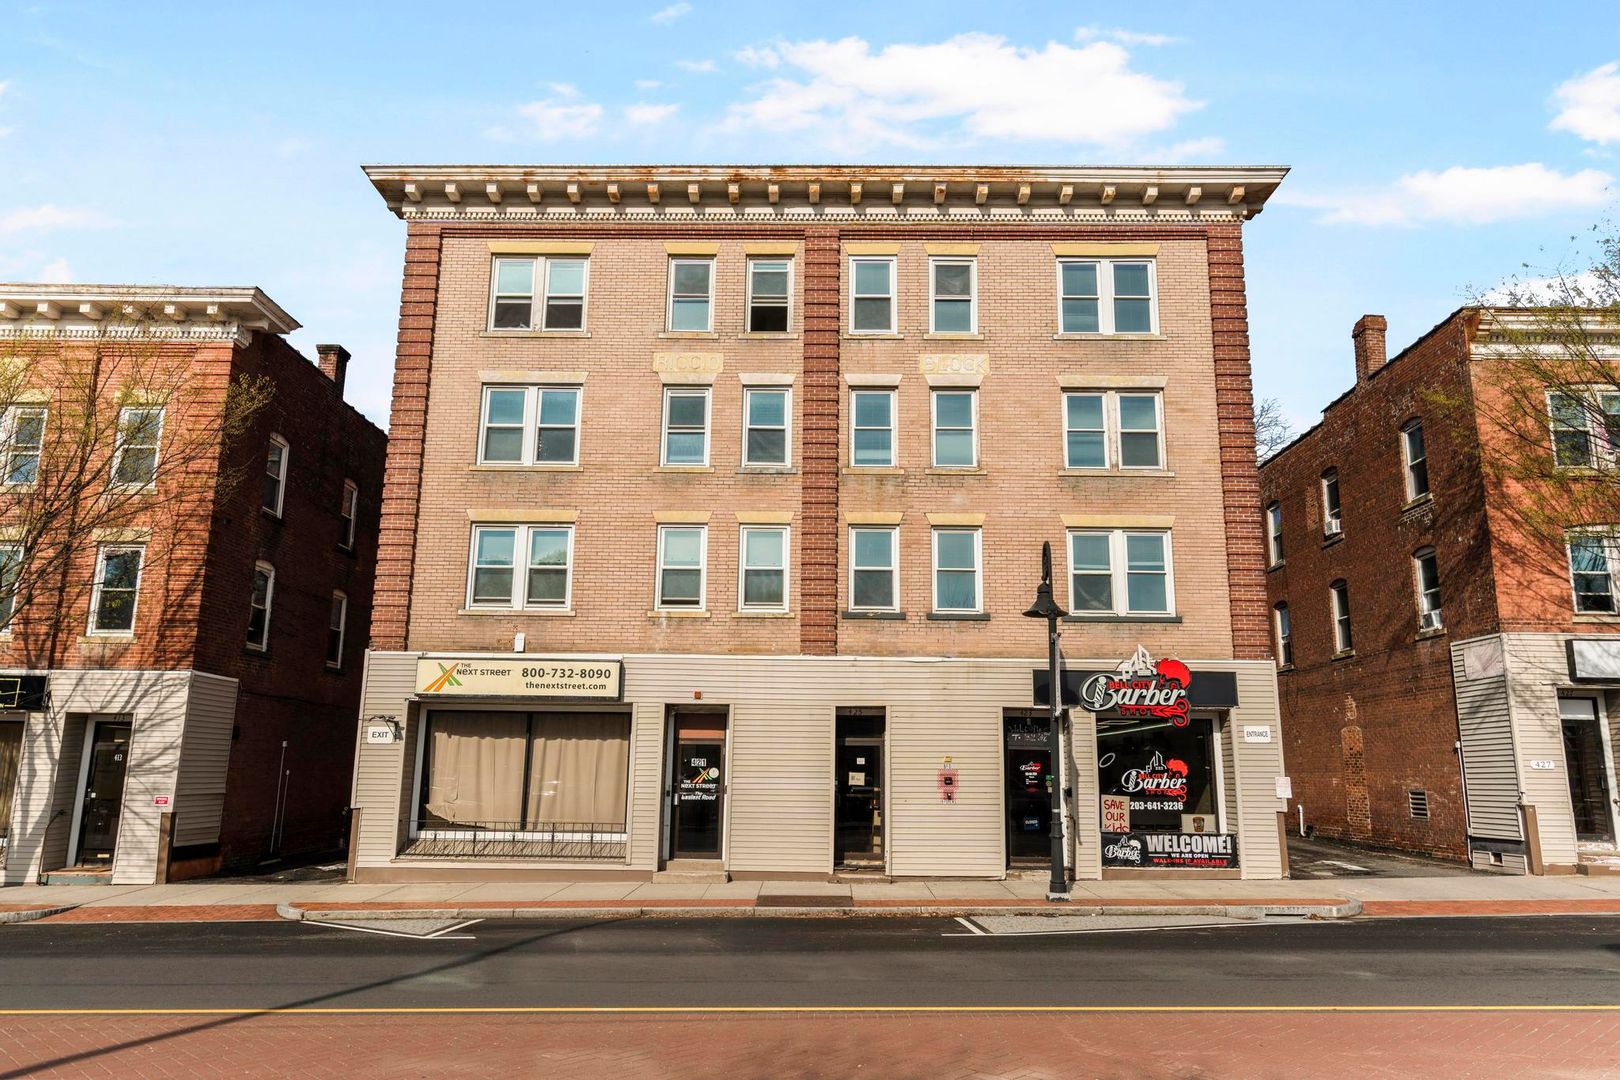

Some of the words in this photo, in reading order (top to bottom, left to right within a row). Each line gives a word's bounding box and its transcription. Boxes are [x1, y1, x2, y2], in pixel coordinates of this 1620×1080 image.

[922, 357, 988, 372] BLOCK
[521, 667, 612, 680] 800-732-8090
[525, 681, 607, 691] thenextstreet.com
[1109, 681, 1129, 690] BELL
[1132, 681, 1152, 690] CITY
[1082, 673, 1186, 711] Barber
[371, 731, 389, 739] EXIT
[1246, 730, 1269, 738] ENTRANCE
[1121, 768, 1187, 792] Barber
[1103, 799, 1125, 811] SAVE
[1130, 801, 1184, 811] 203-641-3236
[1105, 811, 1126, 823] OUR
[1145, 834, 1233, 854] WELCOME!
